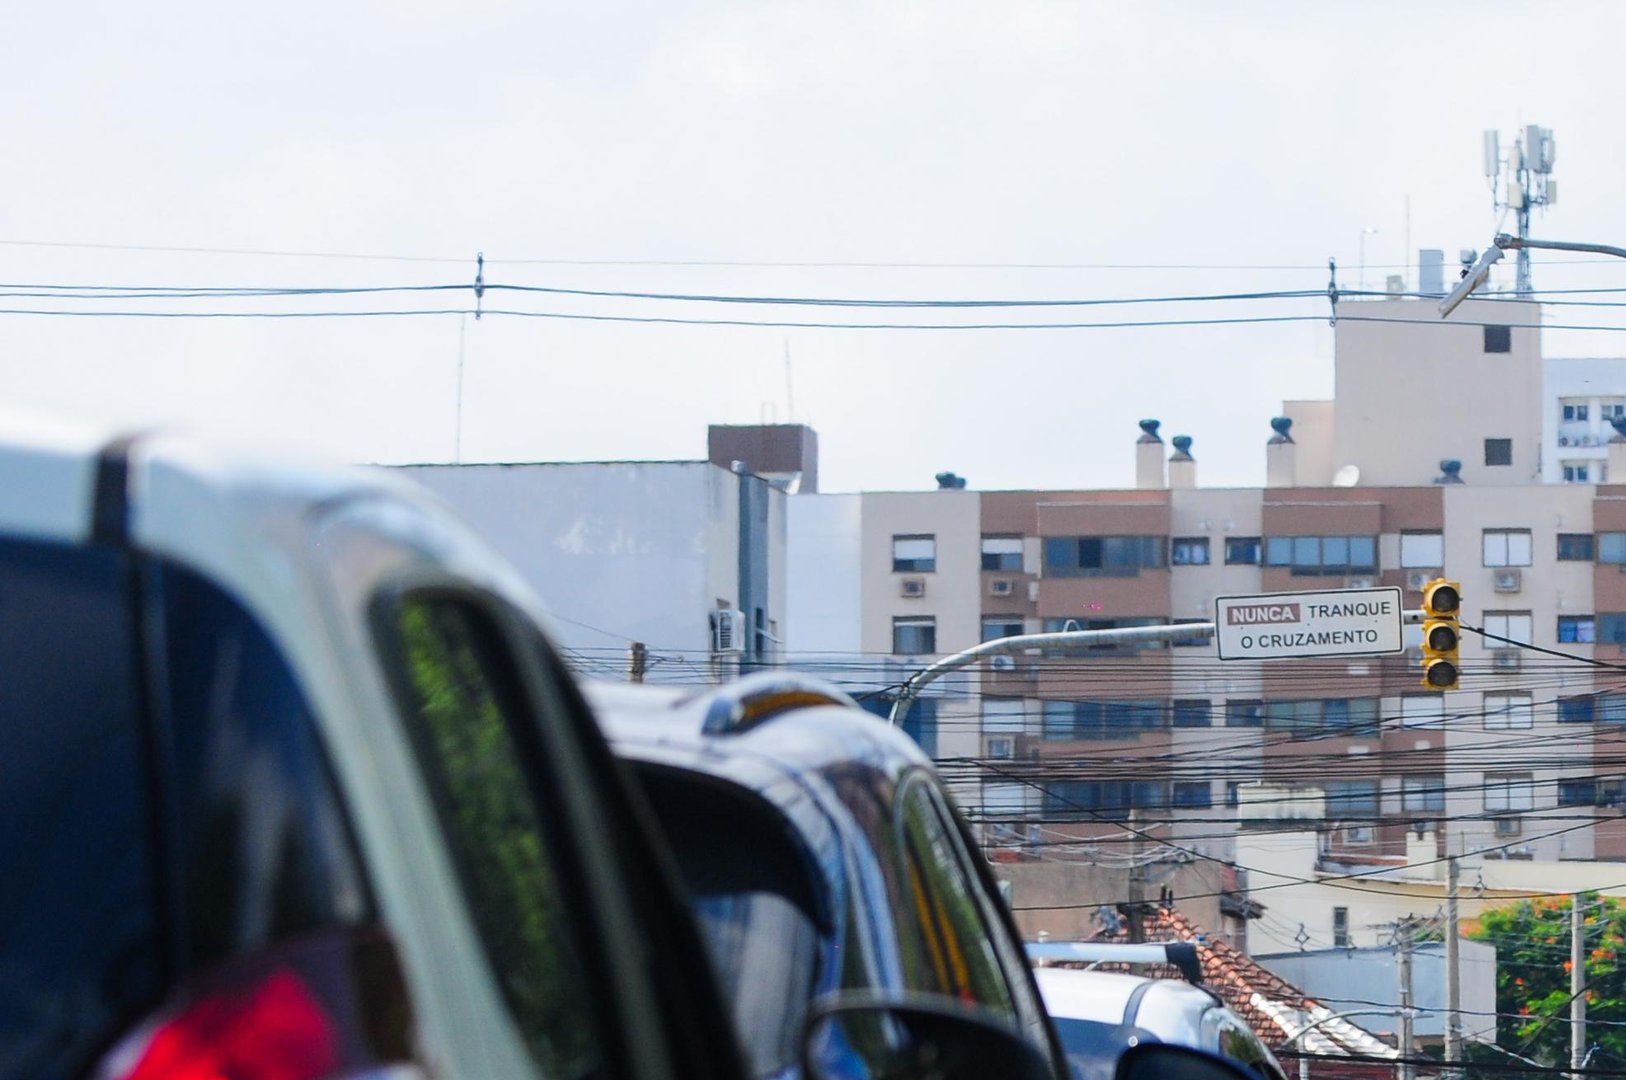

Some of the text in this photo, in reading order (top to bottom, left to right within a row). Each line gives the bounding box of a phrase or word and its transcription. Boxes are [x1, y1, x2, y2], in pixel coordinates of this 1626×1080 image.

[1232, 601, 1391, 623] NUNCA TRANQUE
[1240, 629, 1378, 649] O CRUZAMENTO
